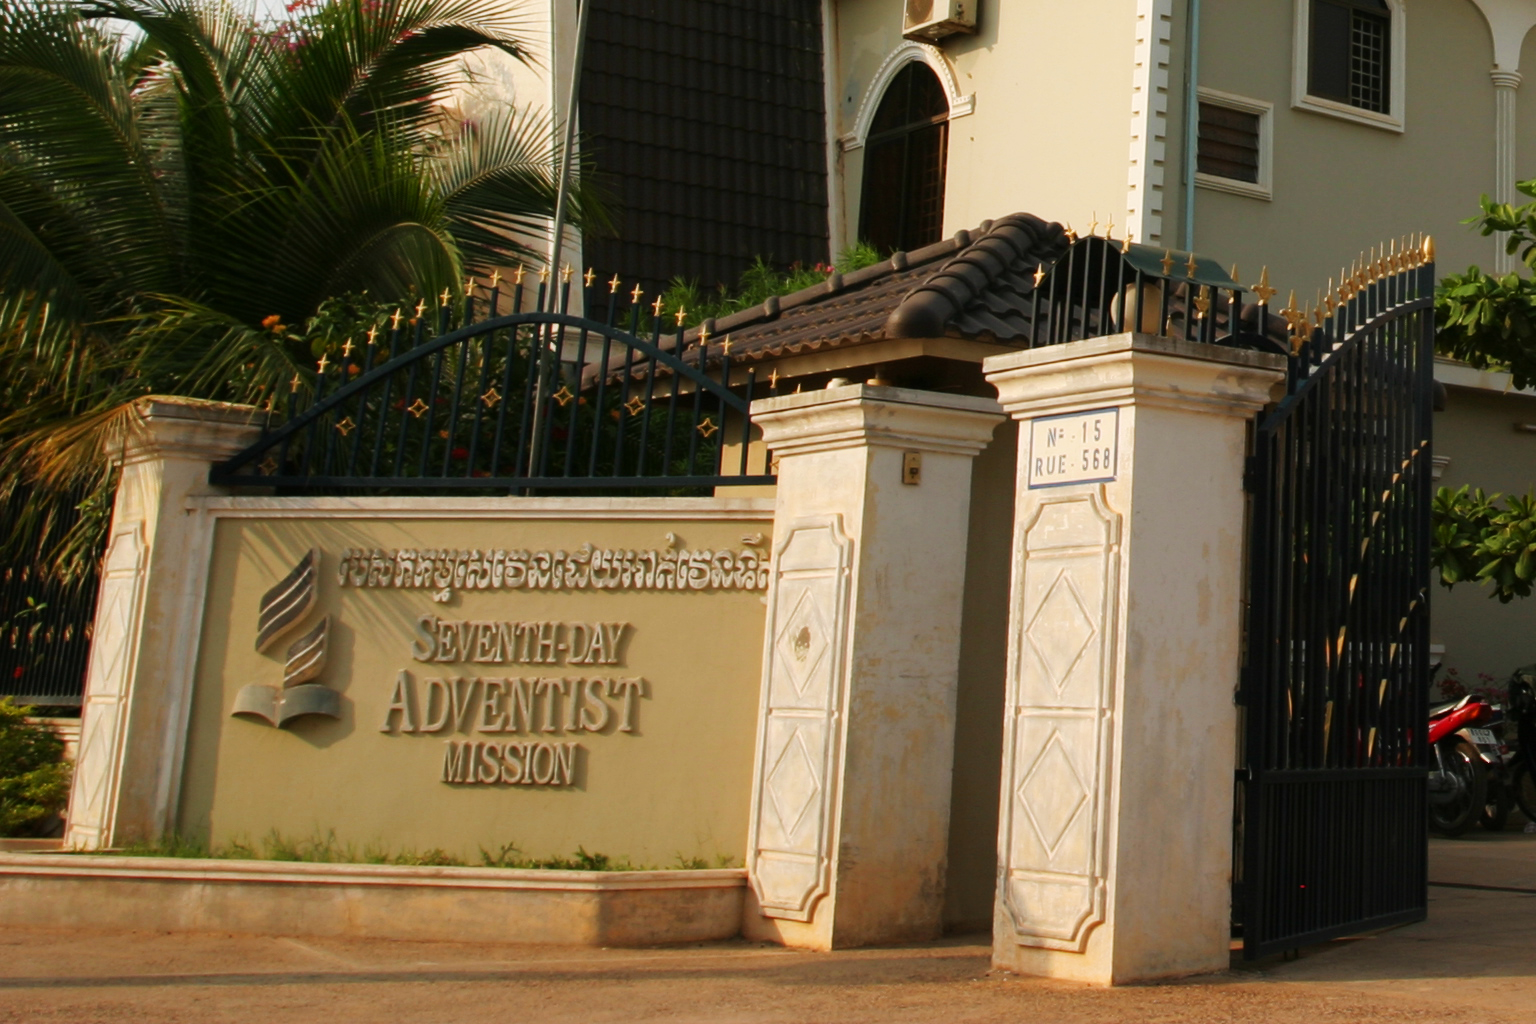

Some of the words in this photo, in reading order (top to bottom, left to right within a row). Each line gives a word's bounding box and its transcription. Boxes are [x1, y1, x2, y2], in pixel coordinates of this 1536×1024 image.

[1082, 420, 1101, 443] 15
[1035, 455, 1066, 477] RUE
[1082, 448, 1110, 471] 568
[412, 614, 629, 665] SEVENTH-DAY
[380, 668, 644, 733] ADVENTIST
[441, 741, 579, 784] MISSION
